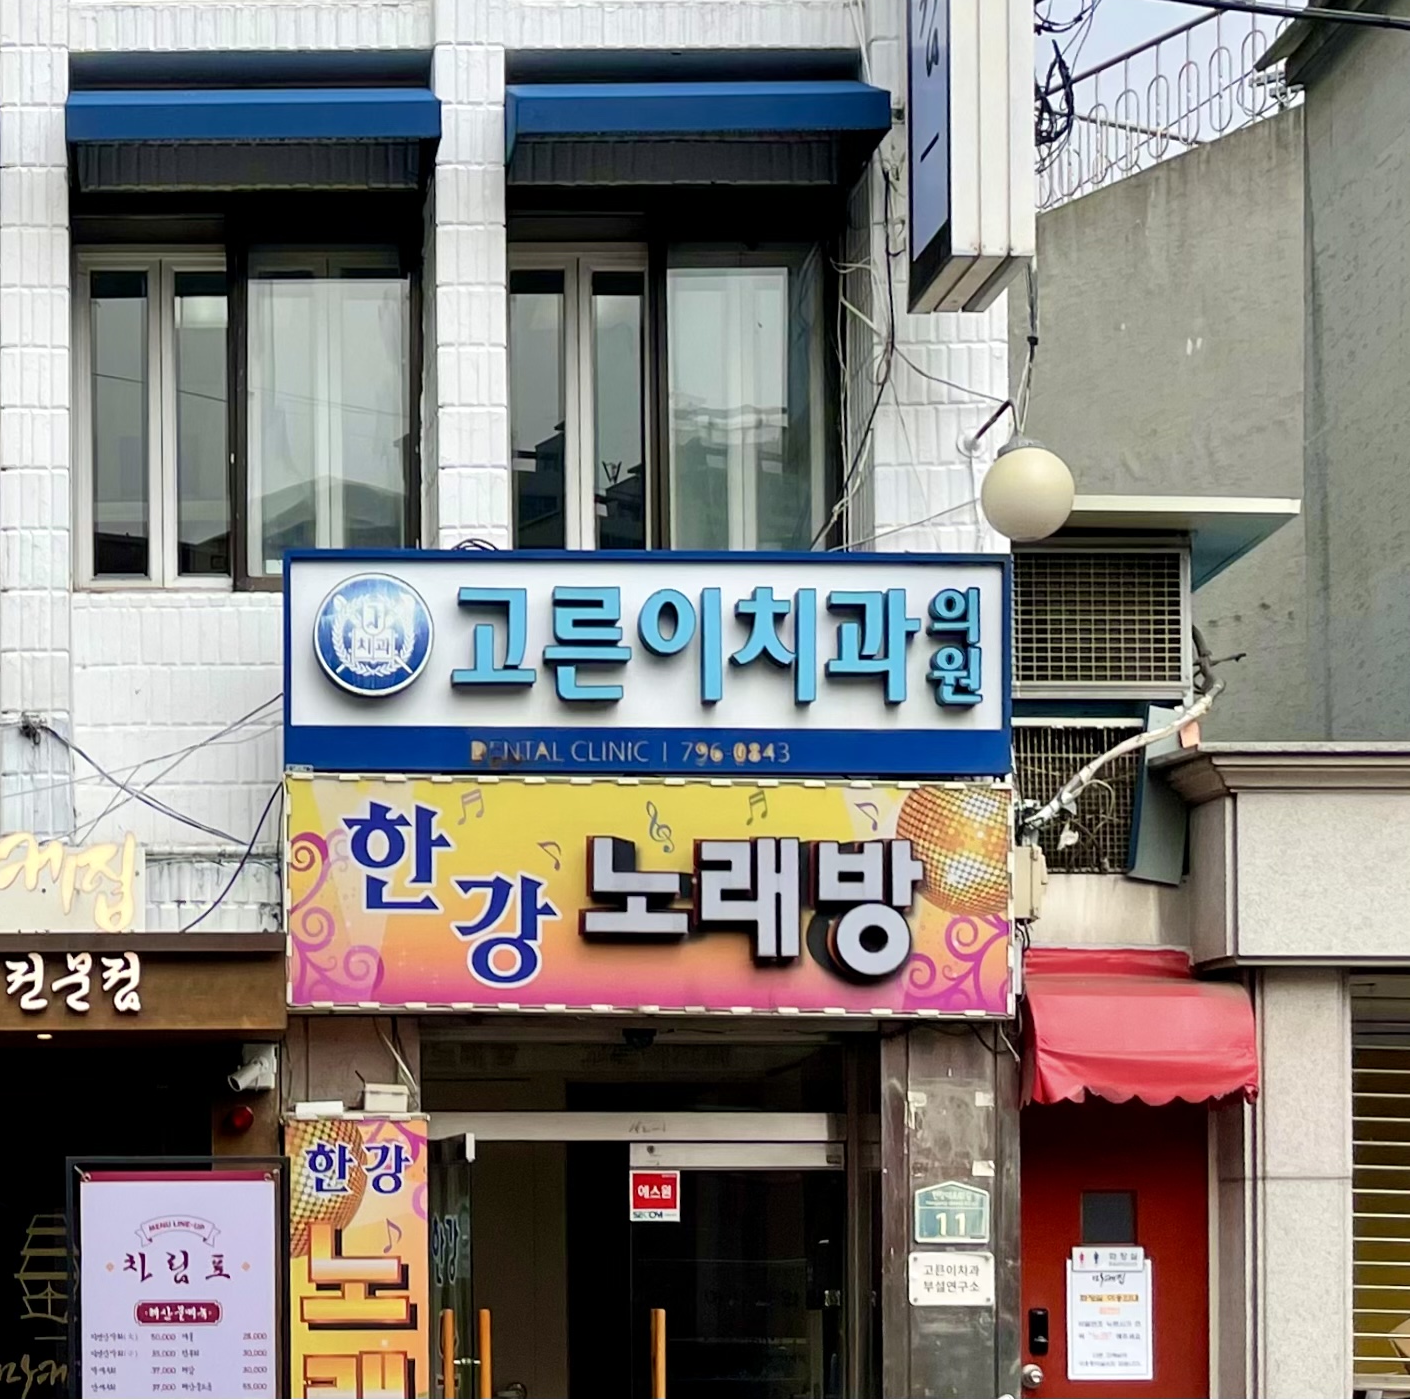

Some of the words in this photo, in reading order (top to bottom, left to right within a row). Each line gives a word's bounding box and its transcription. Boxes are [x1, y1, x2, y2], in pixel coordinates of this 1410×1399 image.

[451, 586, 921, 704] 고른이치과
[926, 586, 983, 707] 의원
[571, 740, 650, 763] CLINIC
[342, 800, 562, 986] 한강
[579, 836, 924, 978] 노래방
[304, 1142, 412, 1196] 한강
[637, 1184, 672, 1200] 에스원
[148, 1220, 172, 1232] MENU
[935, 1212, 967, 1237] 11
[923, 1264, 980, 1277] 고른이치과
[923, 1280, 980, 1293] 부설연구소
